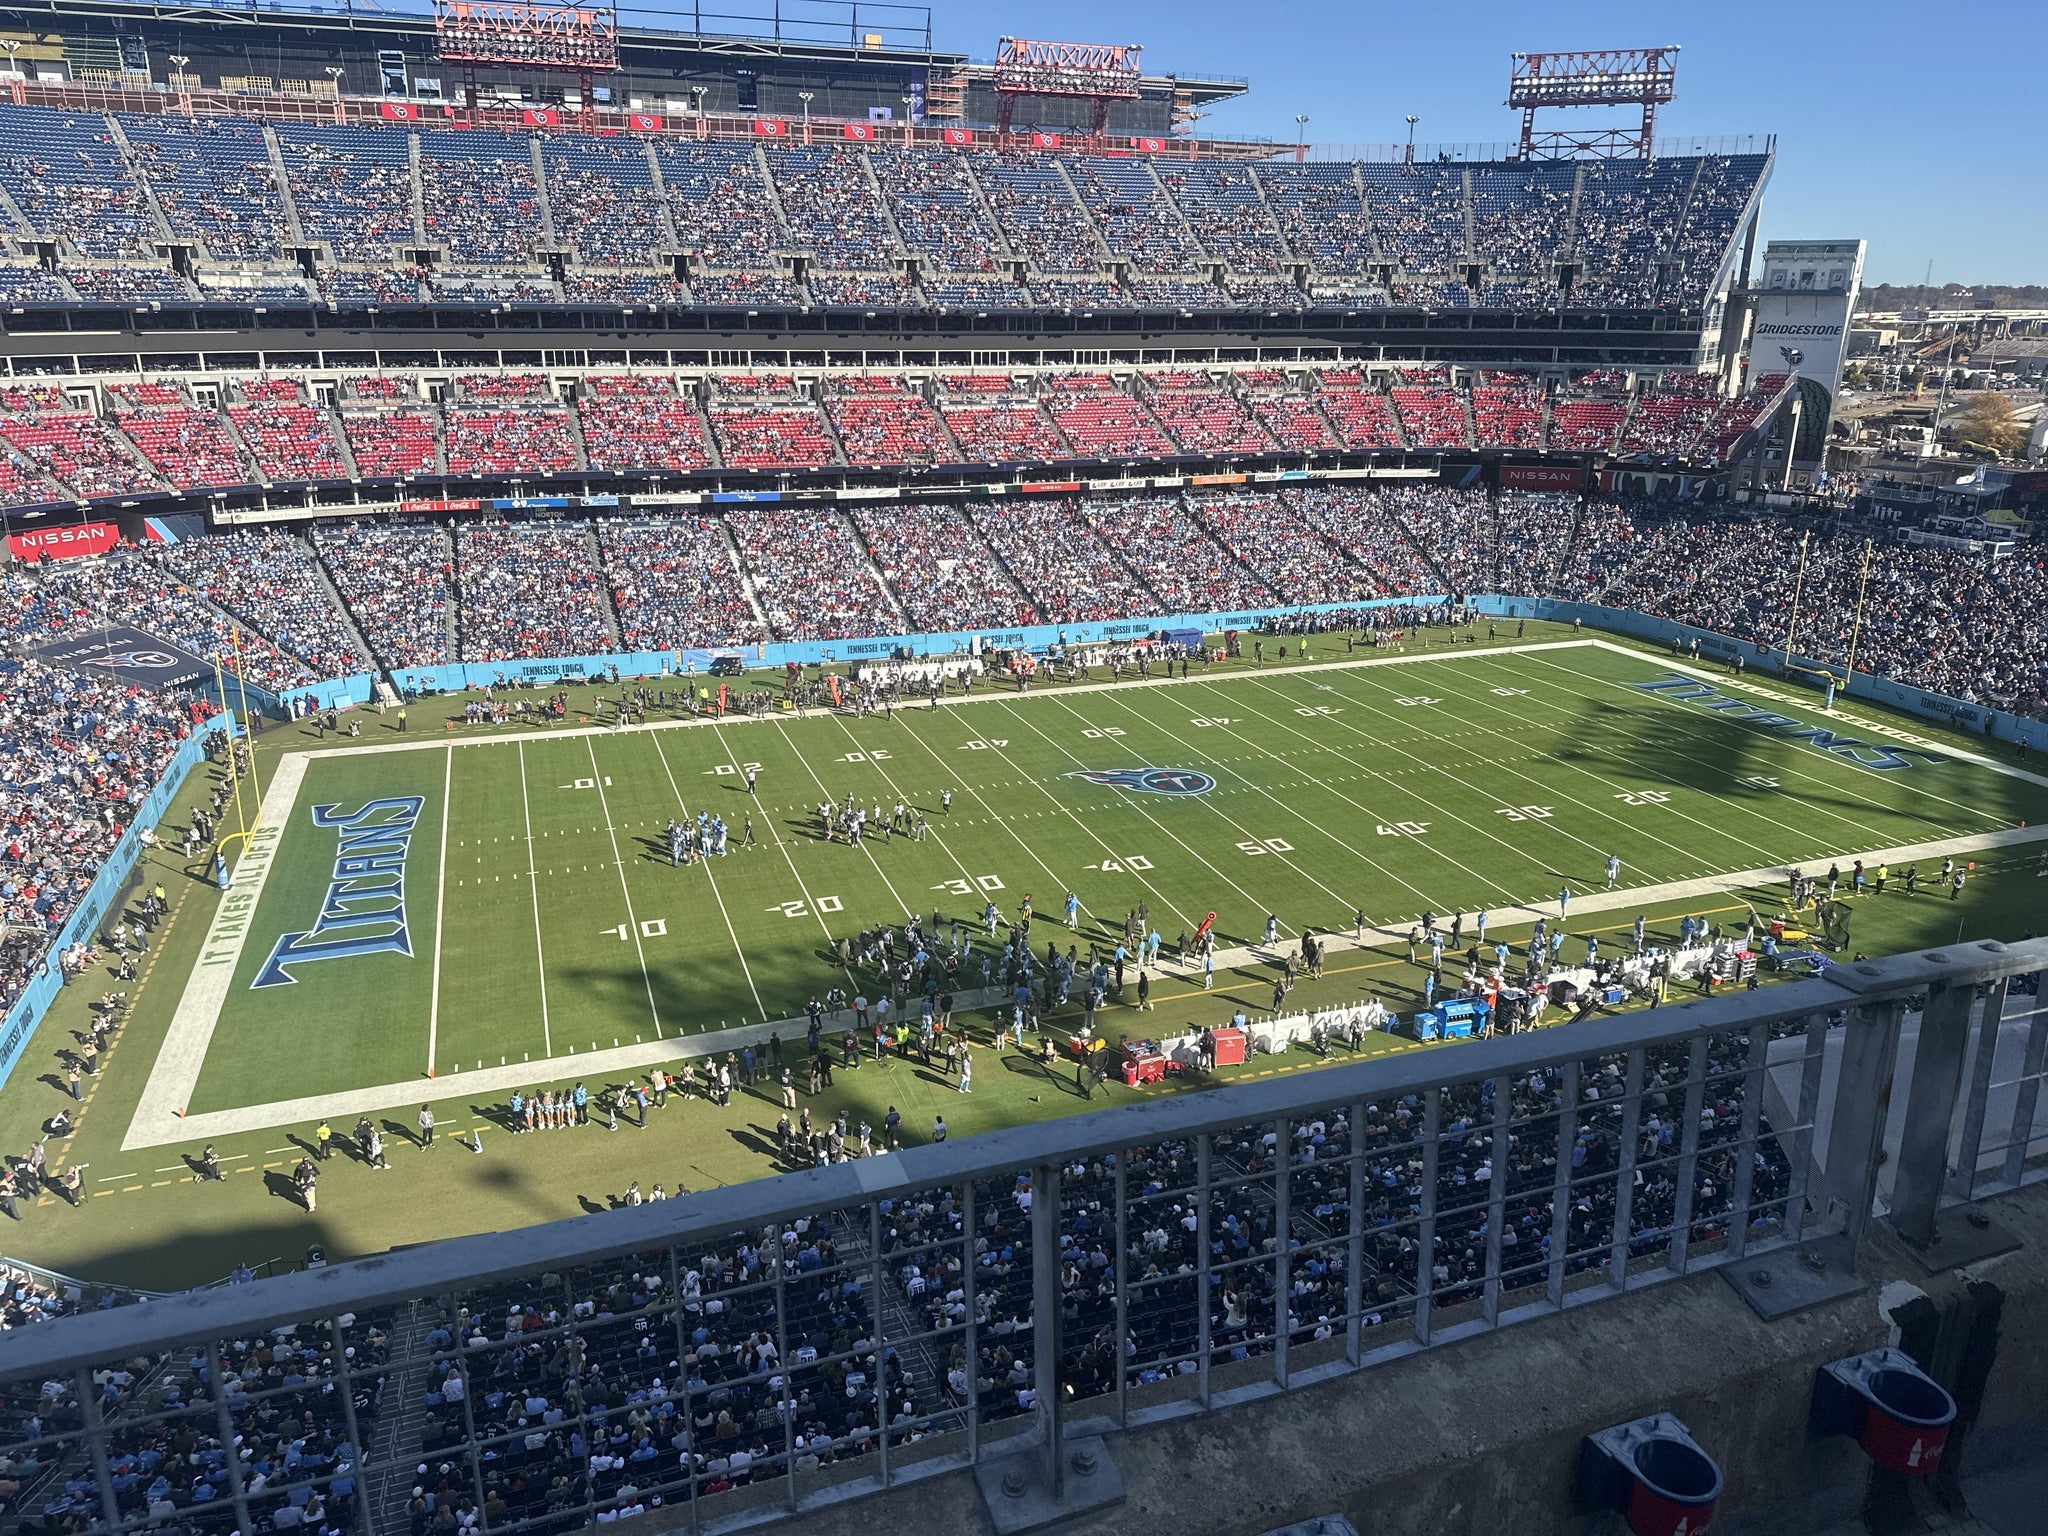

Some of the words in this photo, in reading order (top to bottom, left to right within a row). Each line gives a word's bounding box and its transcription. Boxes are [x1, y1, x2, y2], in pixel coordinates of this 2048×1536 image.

[1756, 323, 1842, 335] BRIDGESTONE
[1510, 471, 1570, 480] NISSAN
[22, 527, 105, 548] NISSAN
[1103, 625, 1131, 635] TENNESSEE
[1132, 624, 1150, 632] TOUGH
[1226, 616, 1252, 626] TENNESSEE
[53, 638, 133, 660] NISSAN
[848, 643, 878, 654] TENNESSEE
[522, 664, 560, 676] TENNESSEE
[562, 663, 584, 674] TOUGH
[163, 672, 199, 688] NISSAN
[1718, 677, 1795, 702] SALUTE
[1832, 712, 1934, 746] SERVICE
[1920, 696, 1954, 714] TENNESSEE
[1190, 717, 1230, 728] 40
[1619, 672, 1950, 770] TITANS
[1081, 726, 1127, 739] 50
[967, 738, 1008, 750] 40
[846, 750, 893, 762] 30
[1614, 790, 1672, 805] 20
[1494, 805, 1554, 821] 30
[254, 826, 279, 843] US
[1376, 821, 1428, 837] 40
[244, 844, 274, 861] OF
[1235, 838, 1296, 855] 50
[1101, 855, 1155, 873] 40
[236, 864, 264, 890] ALL
[944, 875, 1006, 896] 30
[250, 796, 426, 990] TITANS
[780, 896, 844, 918] 20
[210, 892, 254, 944] TAKES
[618, 918, 668, 941] 10
[202, 948, 234, 967] IT
[312, 1252, 320, 1260] C
